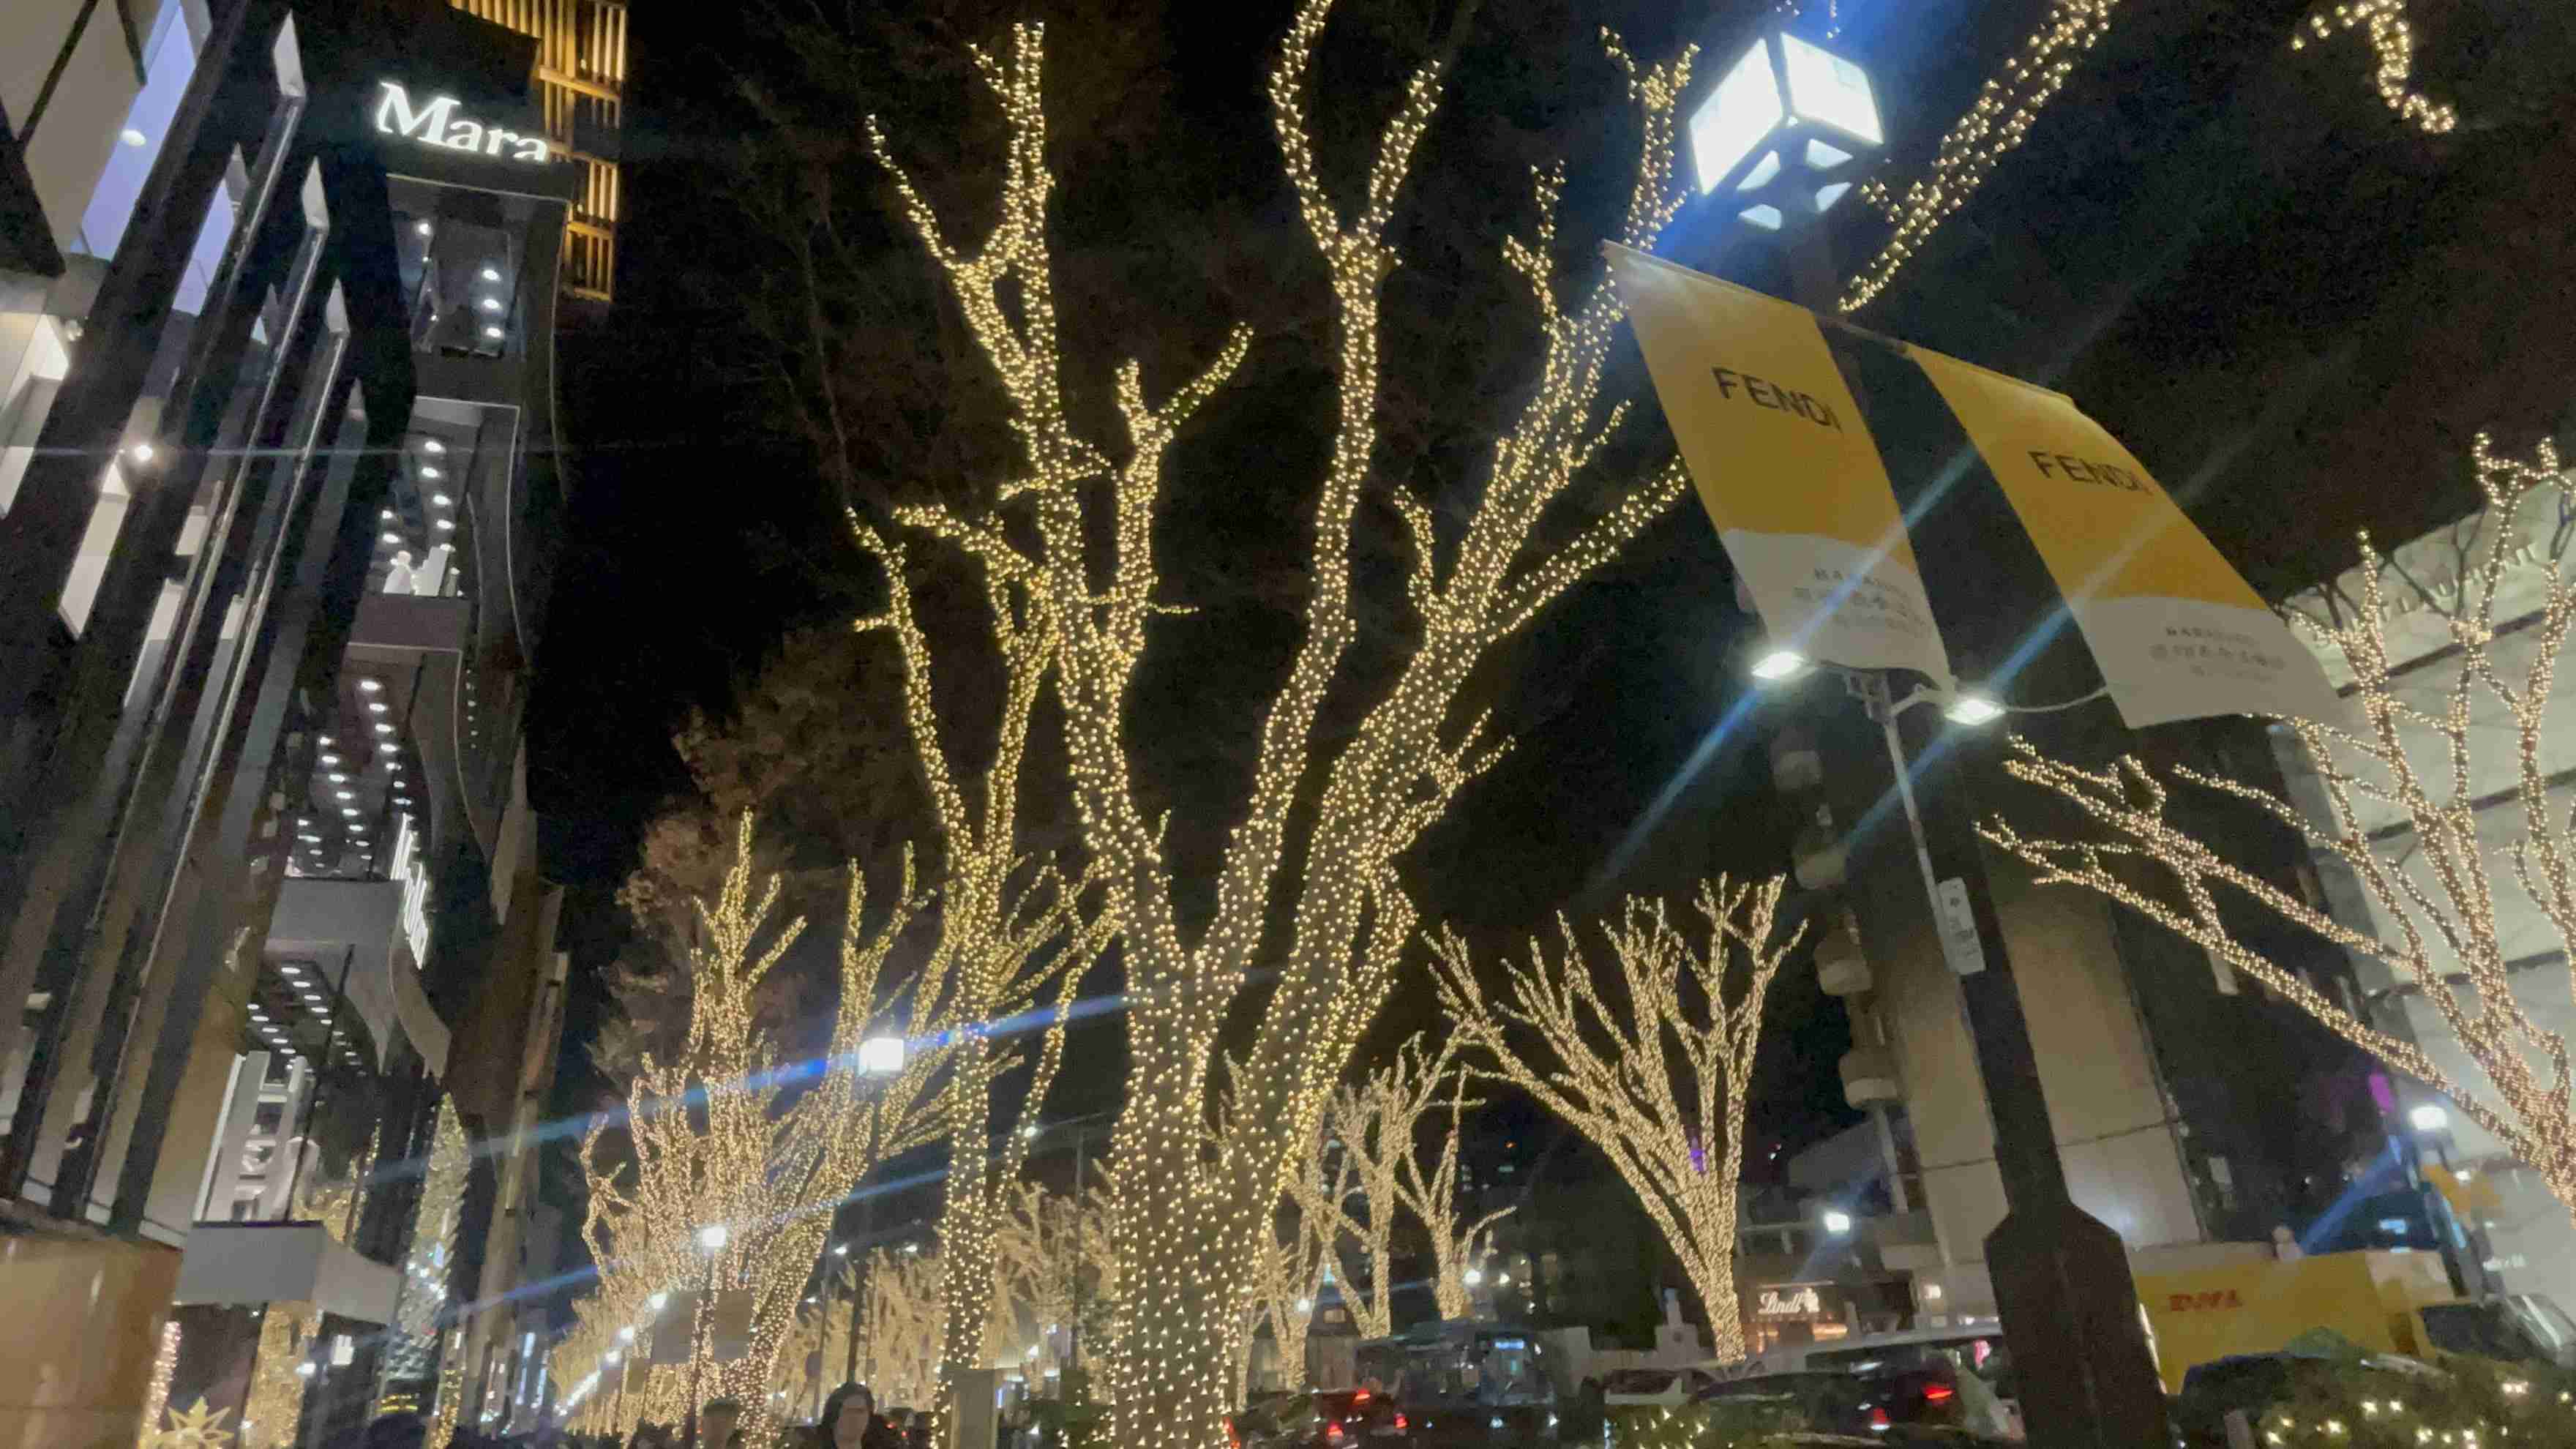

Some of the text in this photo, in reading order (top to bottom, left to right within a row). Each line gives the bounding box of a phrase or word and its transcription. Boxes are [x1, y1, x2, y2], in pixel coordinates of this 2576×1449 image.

[378, 80, 548, 163] Mara
[1711, 366, 1843, 433] FENDI
[2028, 450, 2154, 497] FENDI
